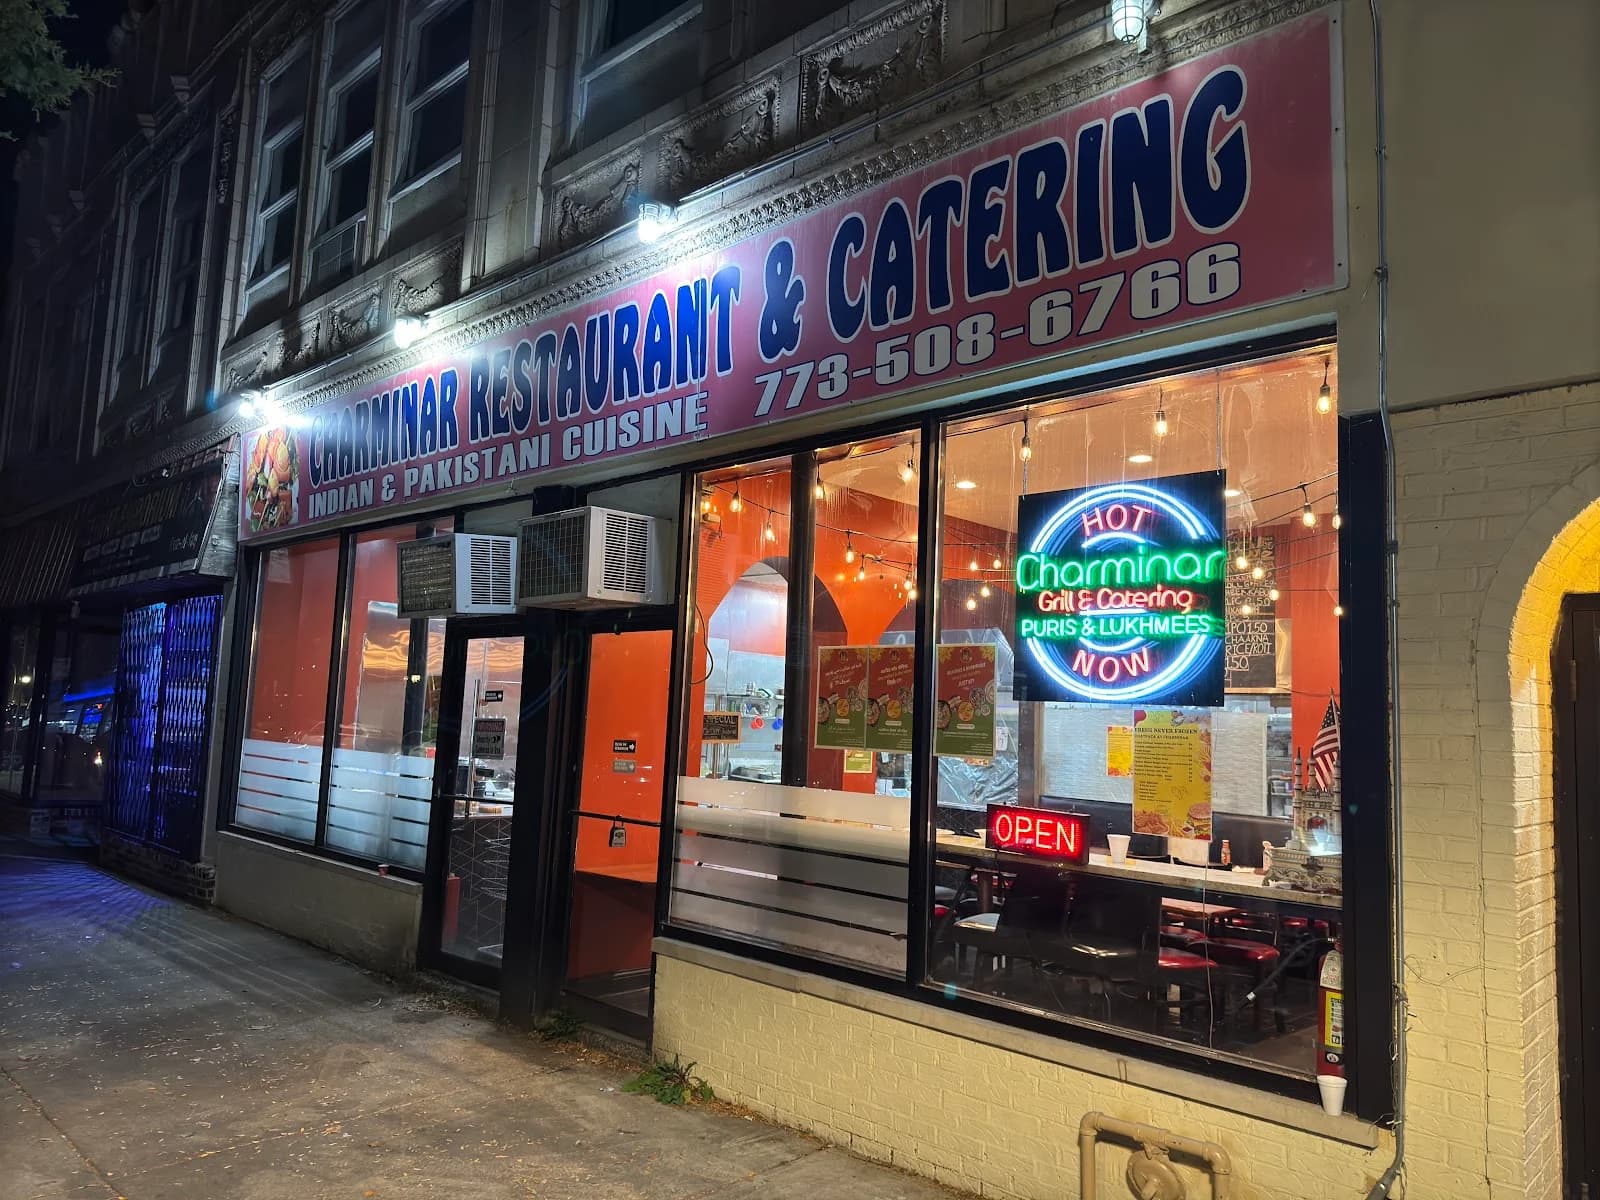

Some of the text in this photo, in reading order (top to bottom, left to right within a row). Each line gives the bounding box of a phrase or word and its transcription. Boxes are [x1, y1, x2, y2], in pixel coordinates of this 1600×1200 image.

[310, 63, 1252, 488] CHARMINAR RESTAURANT & CATERING
[753, 242, 1242, 417] 773-508-6766
[308, 391, 710, 521] INDIAN & PAKISTANI CUISINE
[1081, 504, 1152, 536] HOT
[1016, 546, 1226, 590] Charminar
[1038, 585, 1193, 614] Grill & Catering
[1021, 615, 1211, 637] PURIS & LUKHMEES
[1072, 648, 1149, 683] NOW
[995, 814, 1075, 853] OPEN
